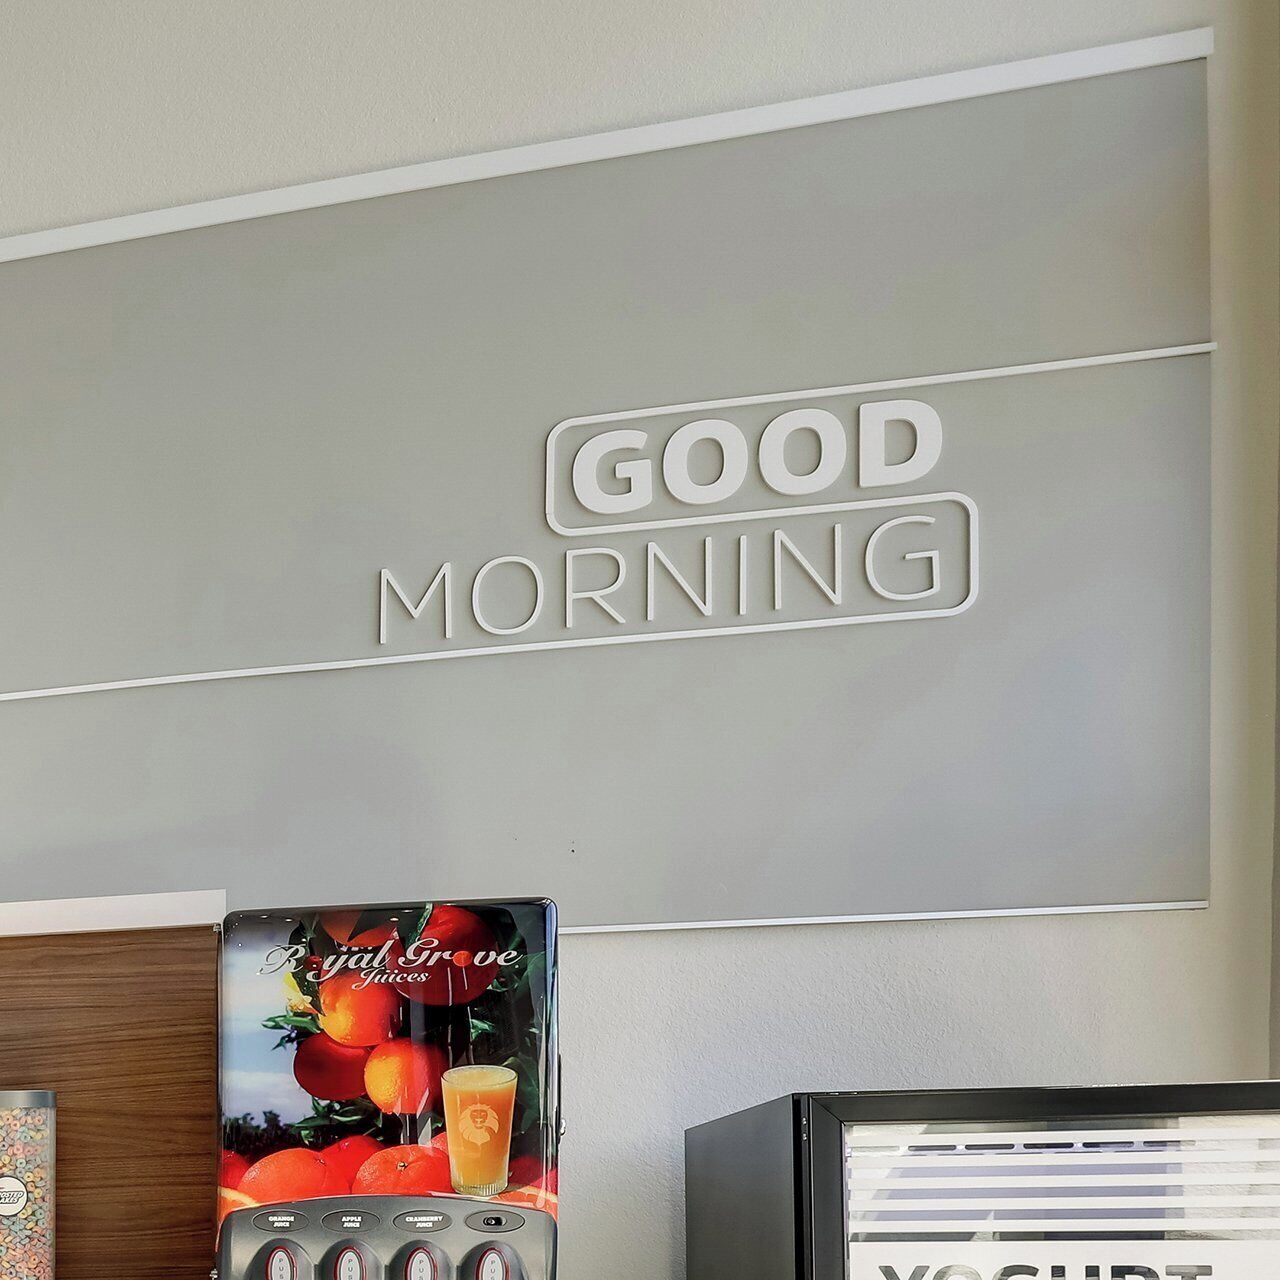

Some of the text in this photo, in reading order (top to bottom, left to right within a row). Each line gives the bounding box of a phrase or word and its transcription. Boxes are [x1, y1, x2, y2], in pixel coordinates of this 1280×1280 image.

[571, 399, 943, 514] GOOD
[379, 515, 941, 644] MORNING
[351, 968, 432, 990] Juices
